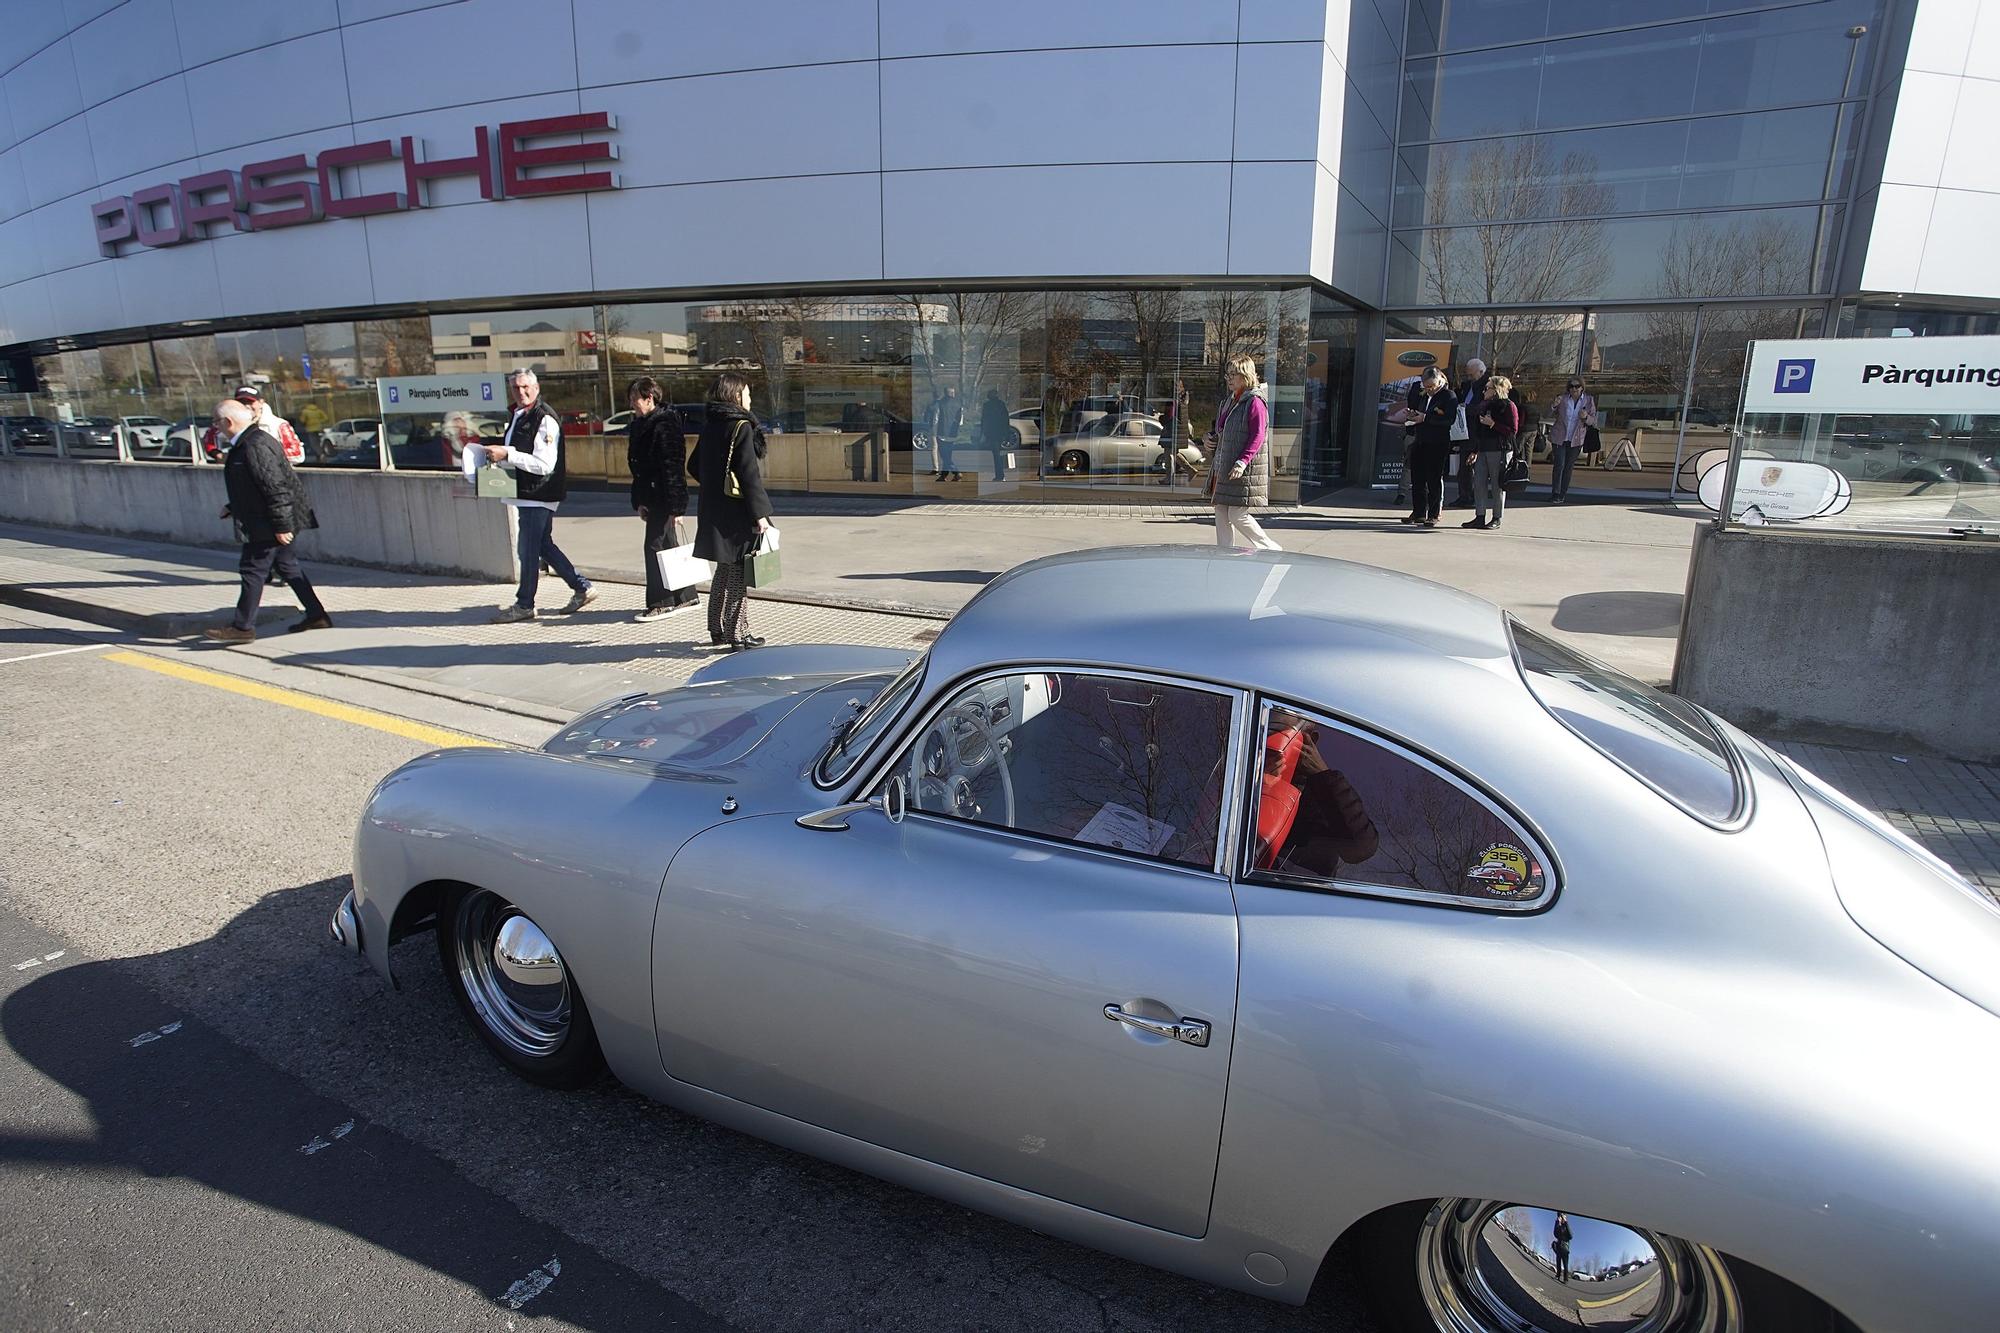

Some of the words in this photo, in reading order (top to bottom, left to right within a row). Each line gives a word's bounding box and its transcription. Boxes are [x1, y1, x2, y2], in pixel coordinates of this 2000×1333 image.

[92, 112, 622, 258] PORSCHE
[1862, 364, 2000, 387] Pàrquing
[408, 387, 441, 399] Pàrquing
[442, 387, 469, 397] Clients
[1479, 842, 1497, 858] CLUB
[1498, 843, 1529, 862] PORSCHE
[1489, 851, 1519, 862] 356
